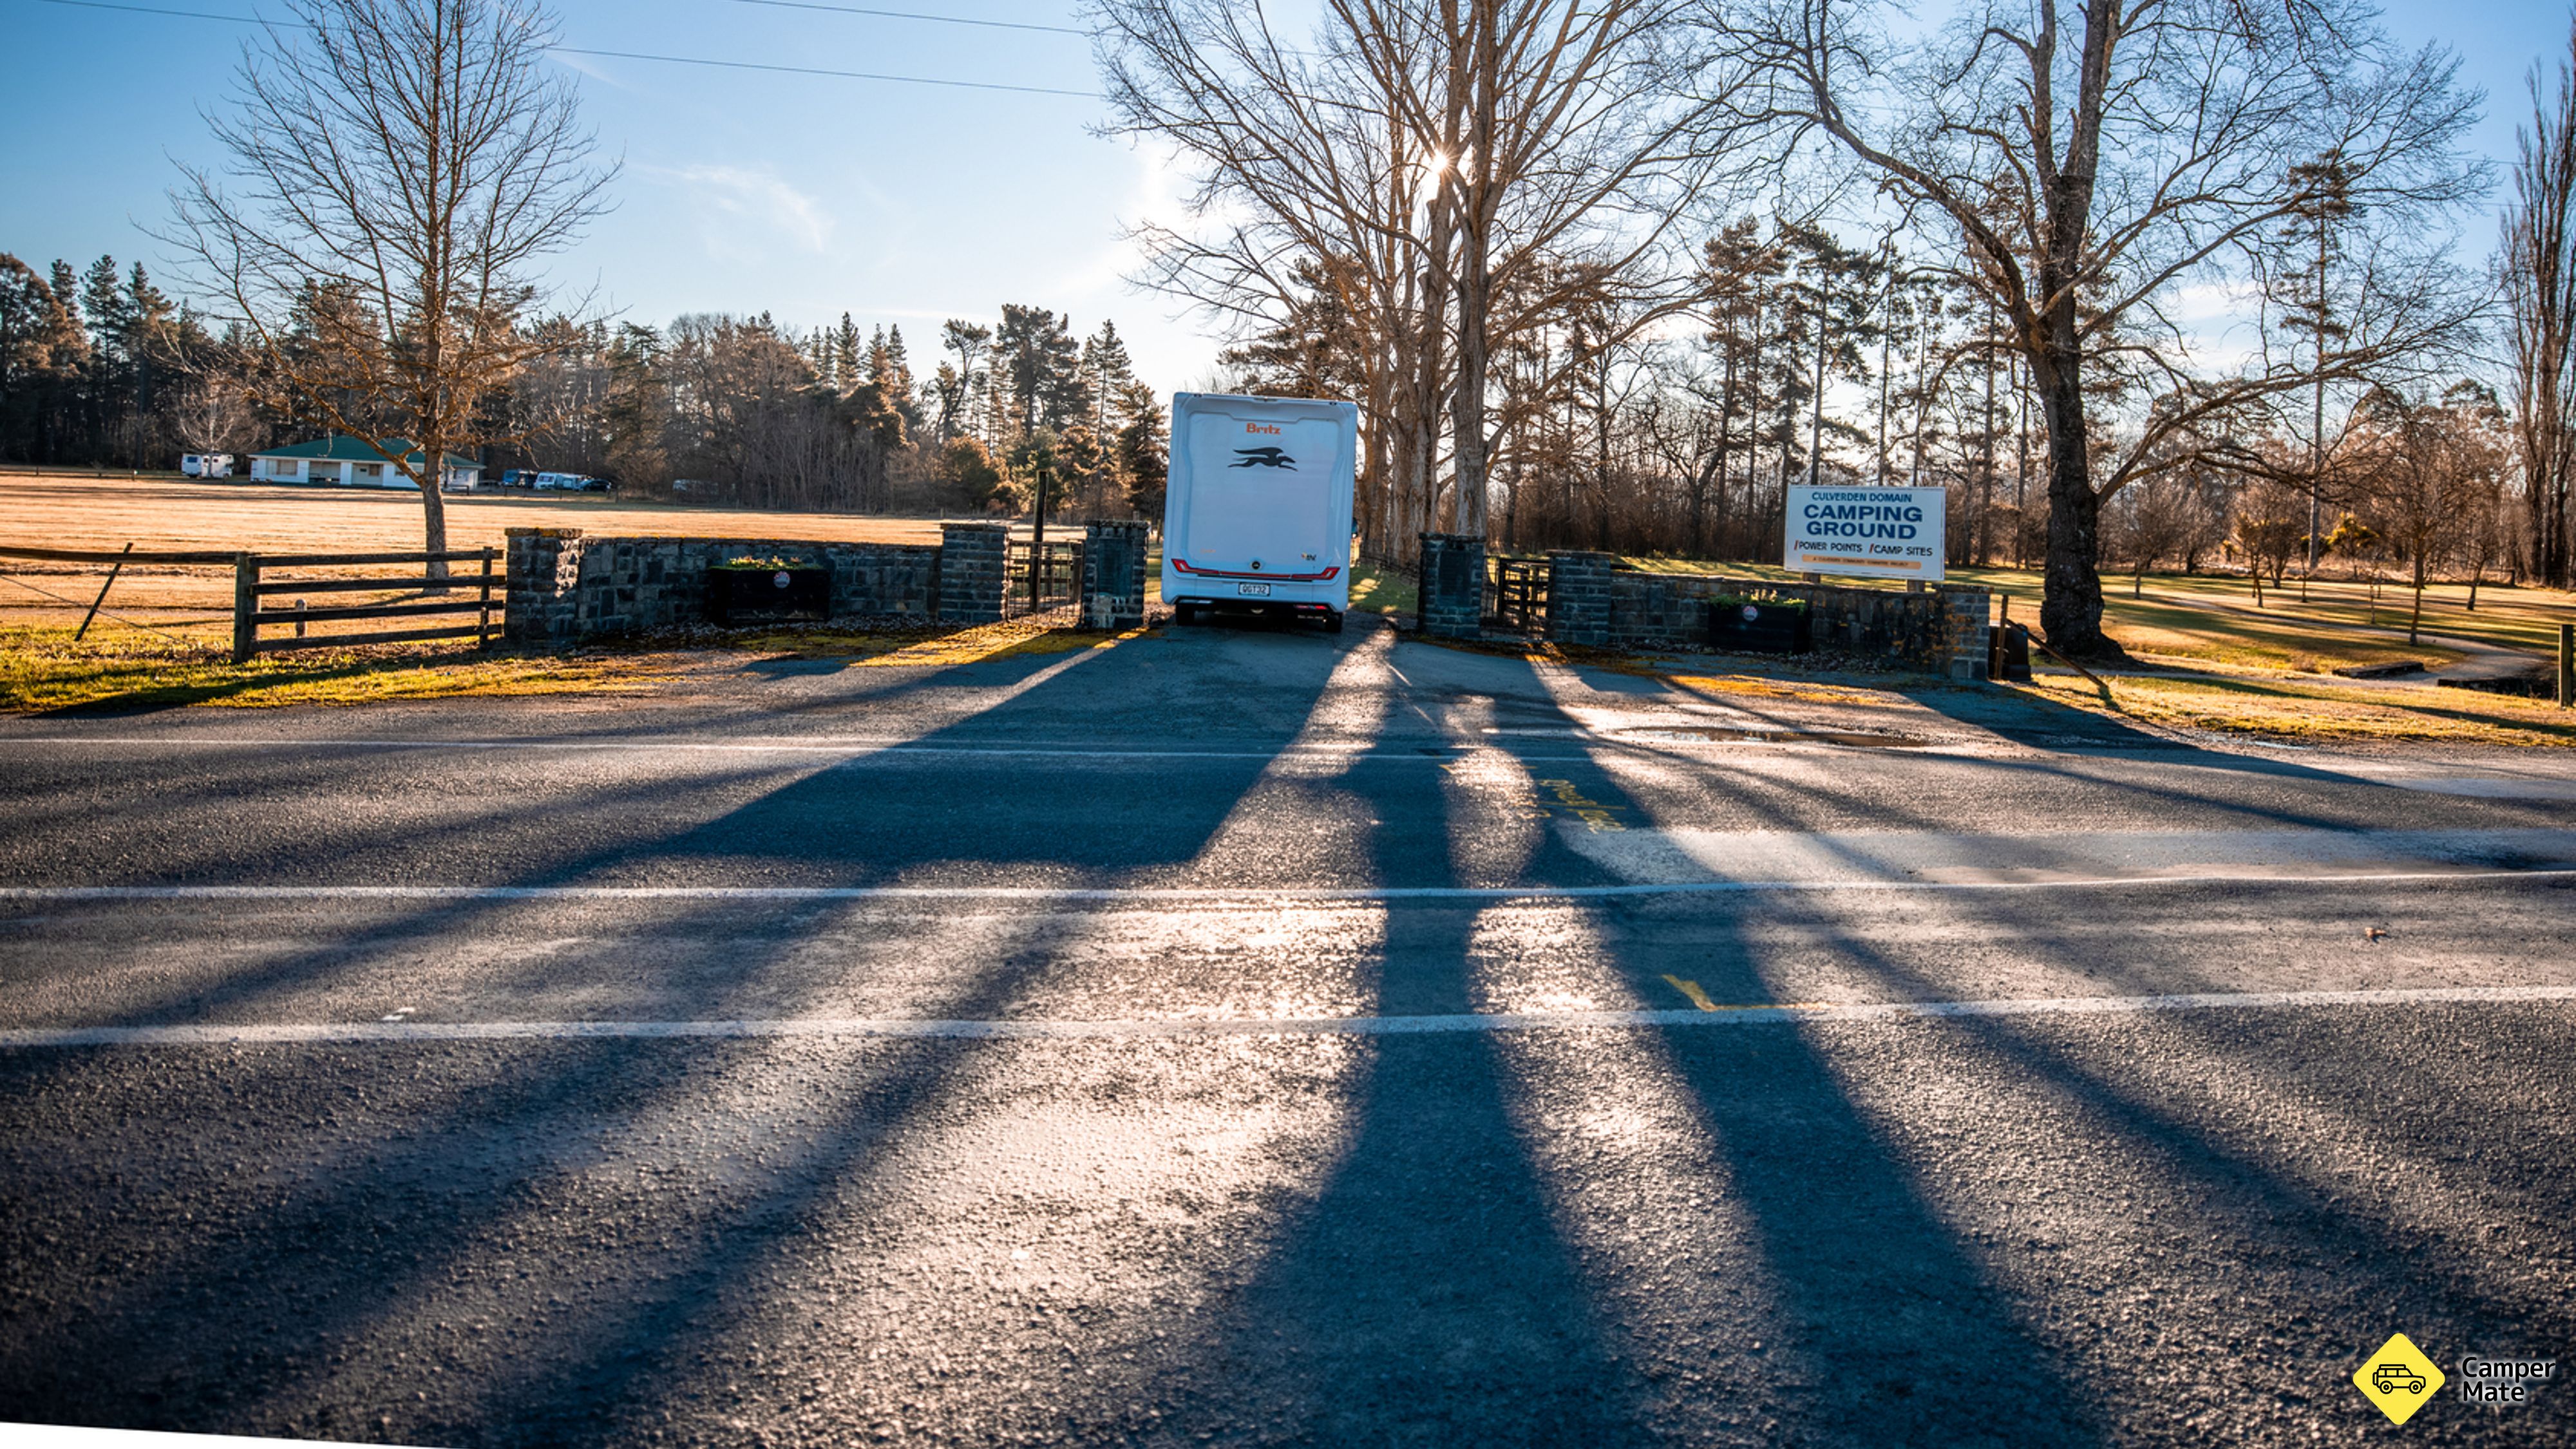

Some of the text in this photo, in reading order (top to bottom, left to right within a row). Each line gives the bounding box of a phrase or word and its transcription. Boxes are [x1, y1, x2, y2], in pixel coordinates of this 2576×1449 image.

[1246, 422, 1281, 435] Britz
[1812, 491, 1912, 502] CULVERDEN DOMAIN
[1804, 504, 1922, 522] CAMPING
[1806, 520, 1917, 539] GROUND
[1831, 543, 1862, 553] POINTS
[1906, 546, 1933, 556] SITES
